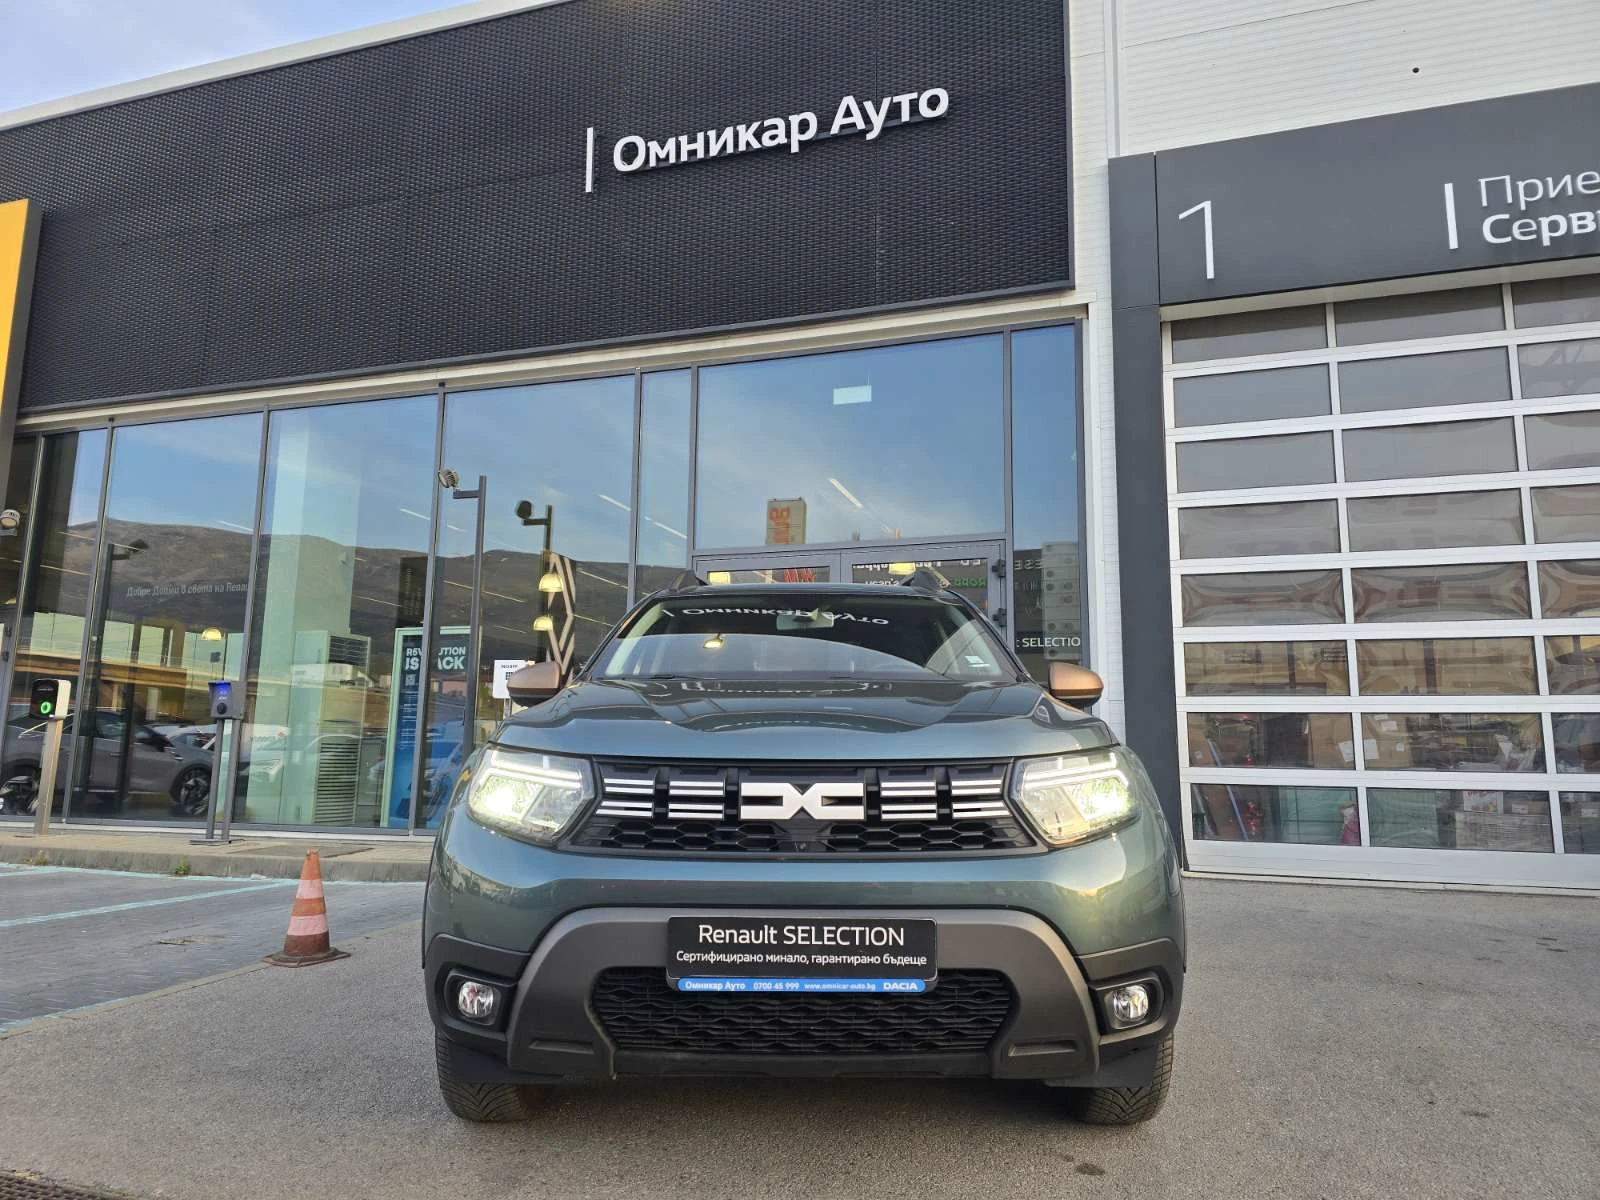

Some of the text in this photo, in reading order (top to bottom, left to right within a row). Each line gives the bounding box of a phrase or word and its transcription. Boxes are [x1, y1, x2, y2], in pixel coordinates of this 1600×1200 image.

[612, 87, 950, 172] Омникар Ауто
[1478, 170, 1600, 211] Прие
[1178, 200, 1215, 280] 1
[1482, 209, 1600, 247] Серв
[698, 923, 905, 947] Renault SELECTION
[676, 950, 927, 966] Сертифицирано минало, гарантирано бъдеще
[684, 981, 746, 992] Омникар Ауто
[753, 982, 773, 991] 0700
[784, 982, 800, 991] 999
[882, 982, 918, 991] DACIA
